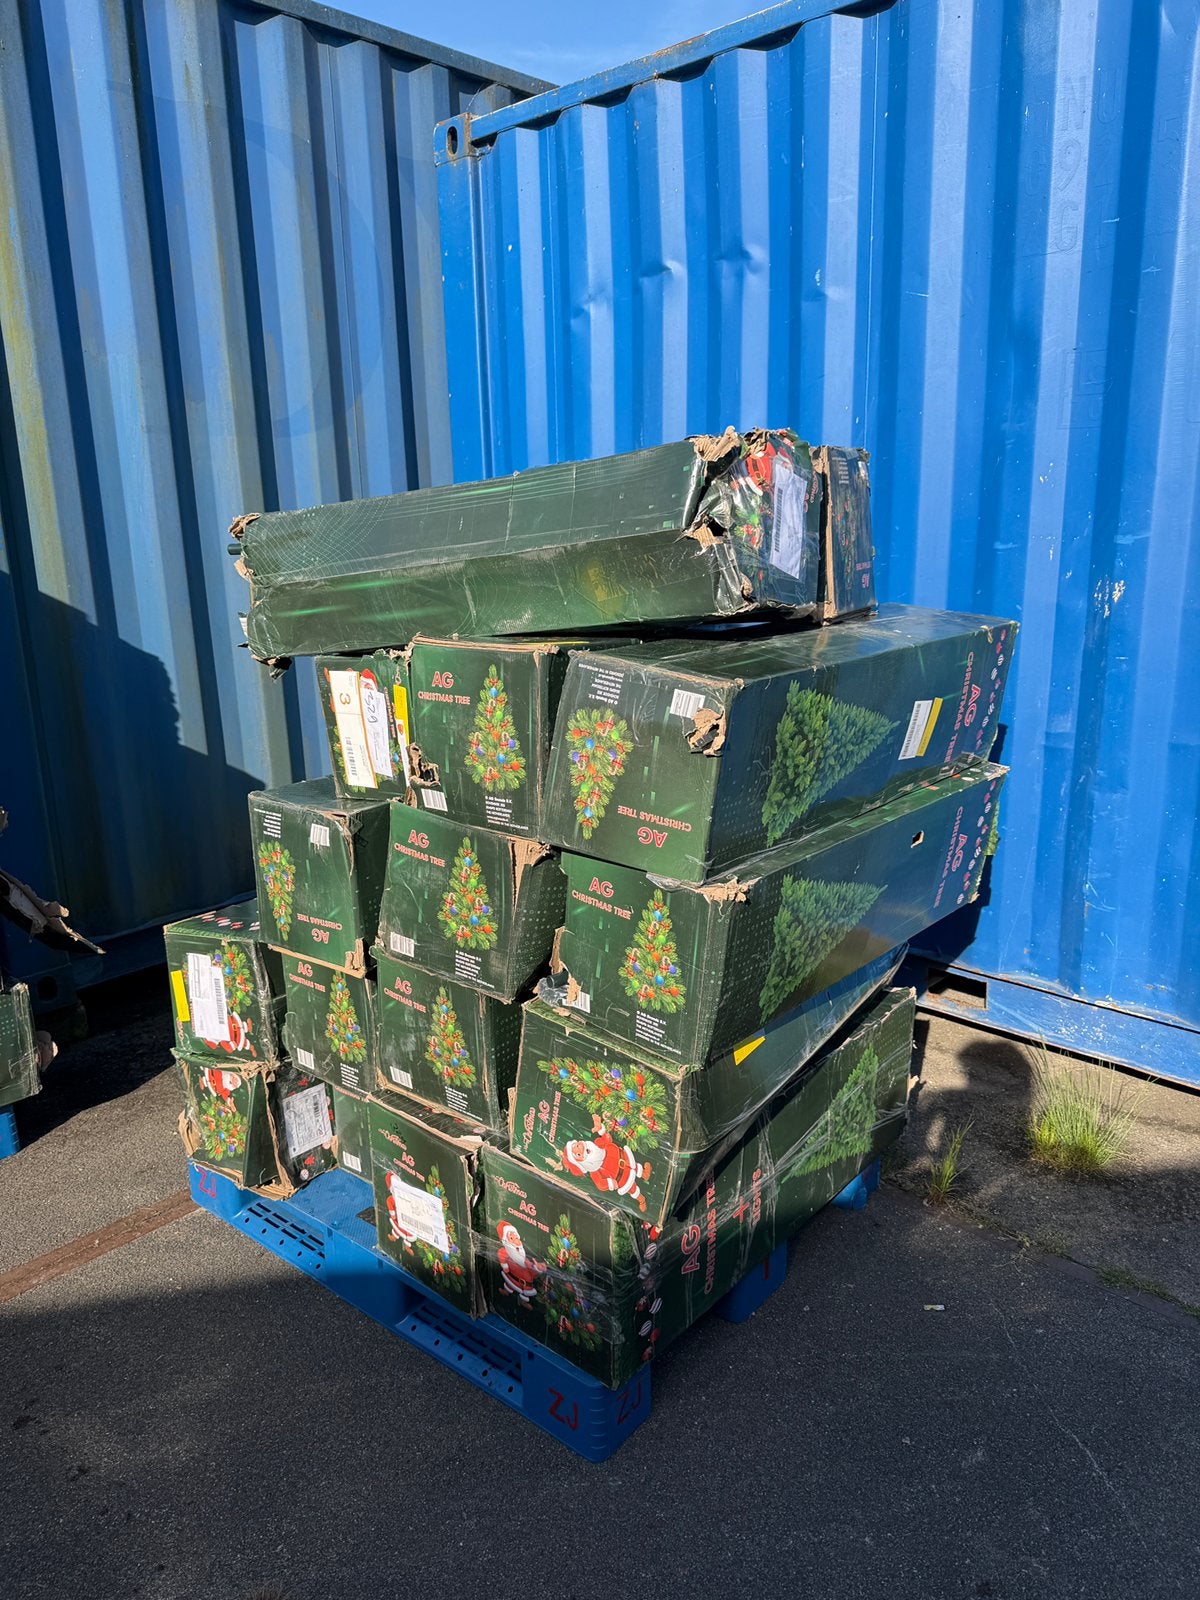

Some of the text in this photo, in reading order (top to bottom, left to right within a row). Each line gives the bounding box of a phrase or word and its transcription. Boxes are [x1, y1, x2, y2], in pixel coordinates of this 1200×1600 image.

[432, 670, 454, 689] AG
[339, 692, 351, 705] 3
[418, 691, 471, 705] CHRISTMAS TREE
[944, 651, 974, 763] CHRISTMAS TREE
[964, 684, 981, 727] AG
[617, 805, 692, 832] CHRISTMAS TREE
[407, 829, 430, 849] AG
[637, 826, 668, 848] AG
[394, 842, 446, 867] CHRISTMAS TREE
[933, 806, 964, 908] CHRISTMAS TREE
[951, 833, 968, 872] AG
[588, 876, 614, 898] AG
[571, 889, 632, 920] CHRISTMAS TREE
[296, 912, 343, 931] CHRISTMAS TREE
[311, 928, 330, 944] AG
[298, 961, 313, 977] AG
[394, 976, 412, 995] AG
[383, 987, 427, 1013] CHRISTMAS TREE
[537, 1099, 551, 1124] AG
[548, 1090, 561, 1143] CHRISTMAS TREE
[401, 1151, 415, 1167] AG
[197, 1167, 217, 1199] ZJ
[519, 1200, 537, 1216] AG
[752, 1168, 762, 1226] LIGHTS
[507, 1207, 550, 1233] CHRISTMAS TREE
[704, 1169, 716, 1295] CHRISTMAS TREE
[681, 1224, 701, 1275] AG
[547, 1387, 579, 1431] ZJ
[617, 1381, 641, 1425] ZJ
